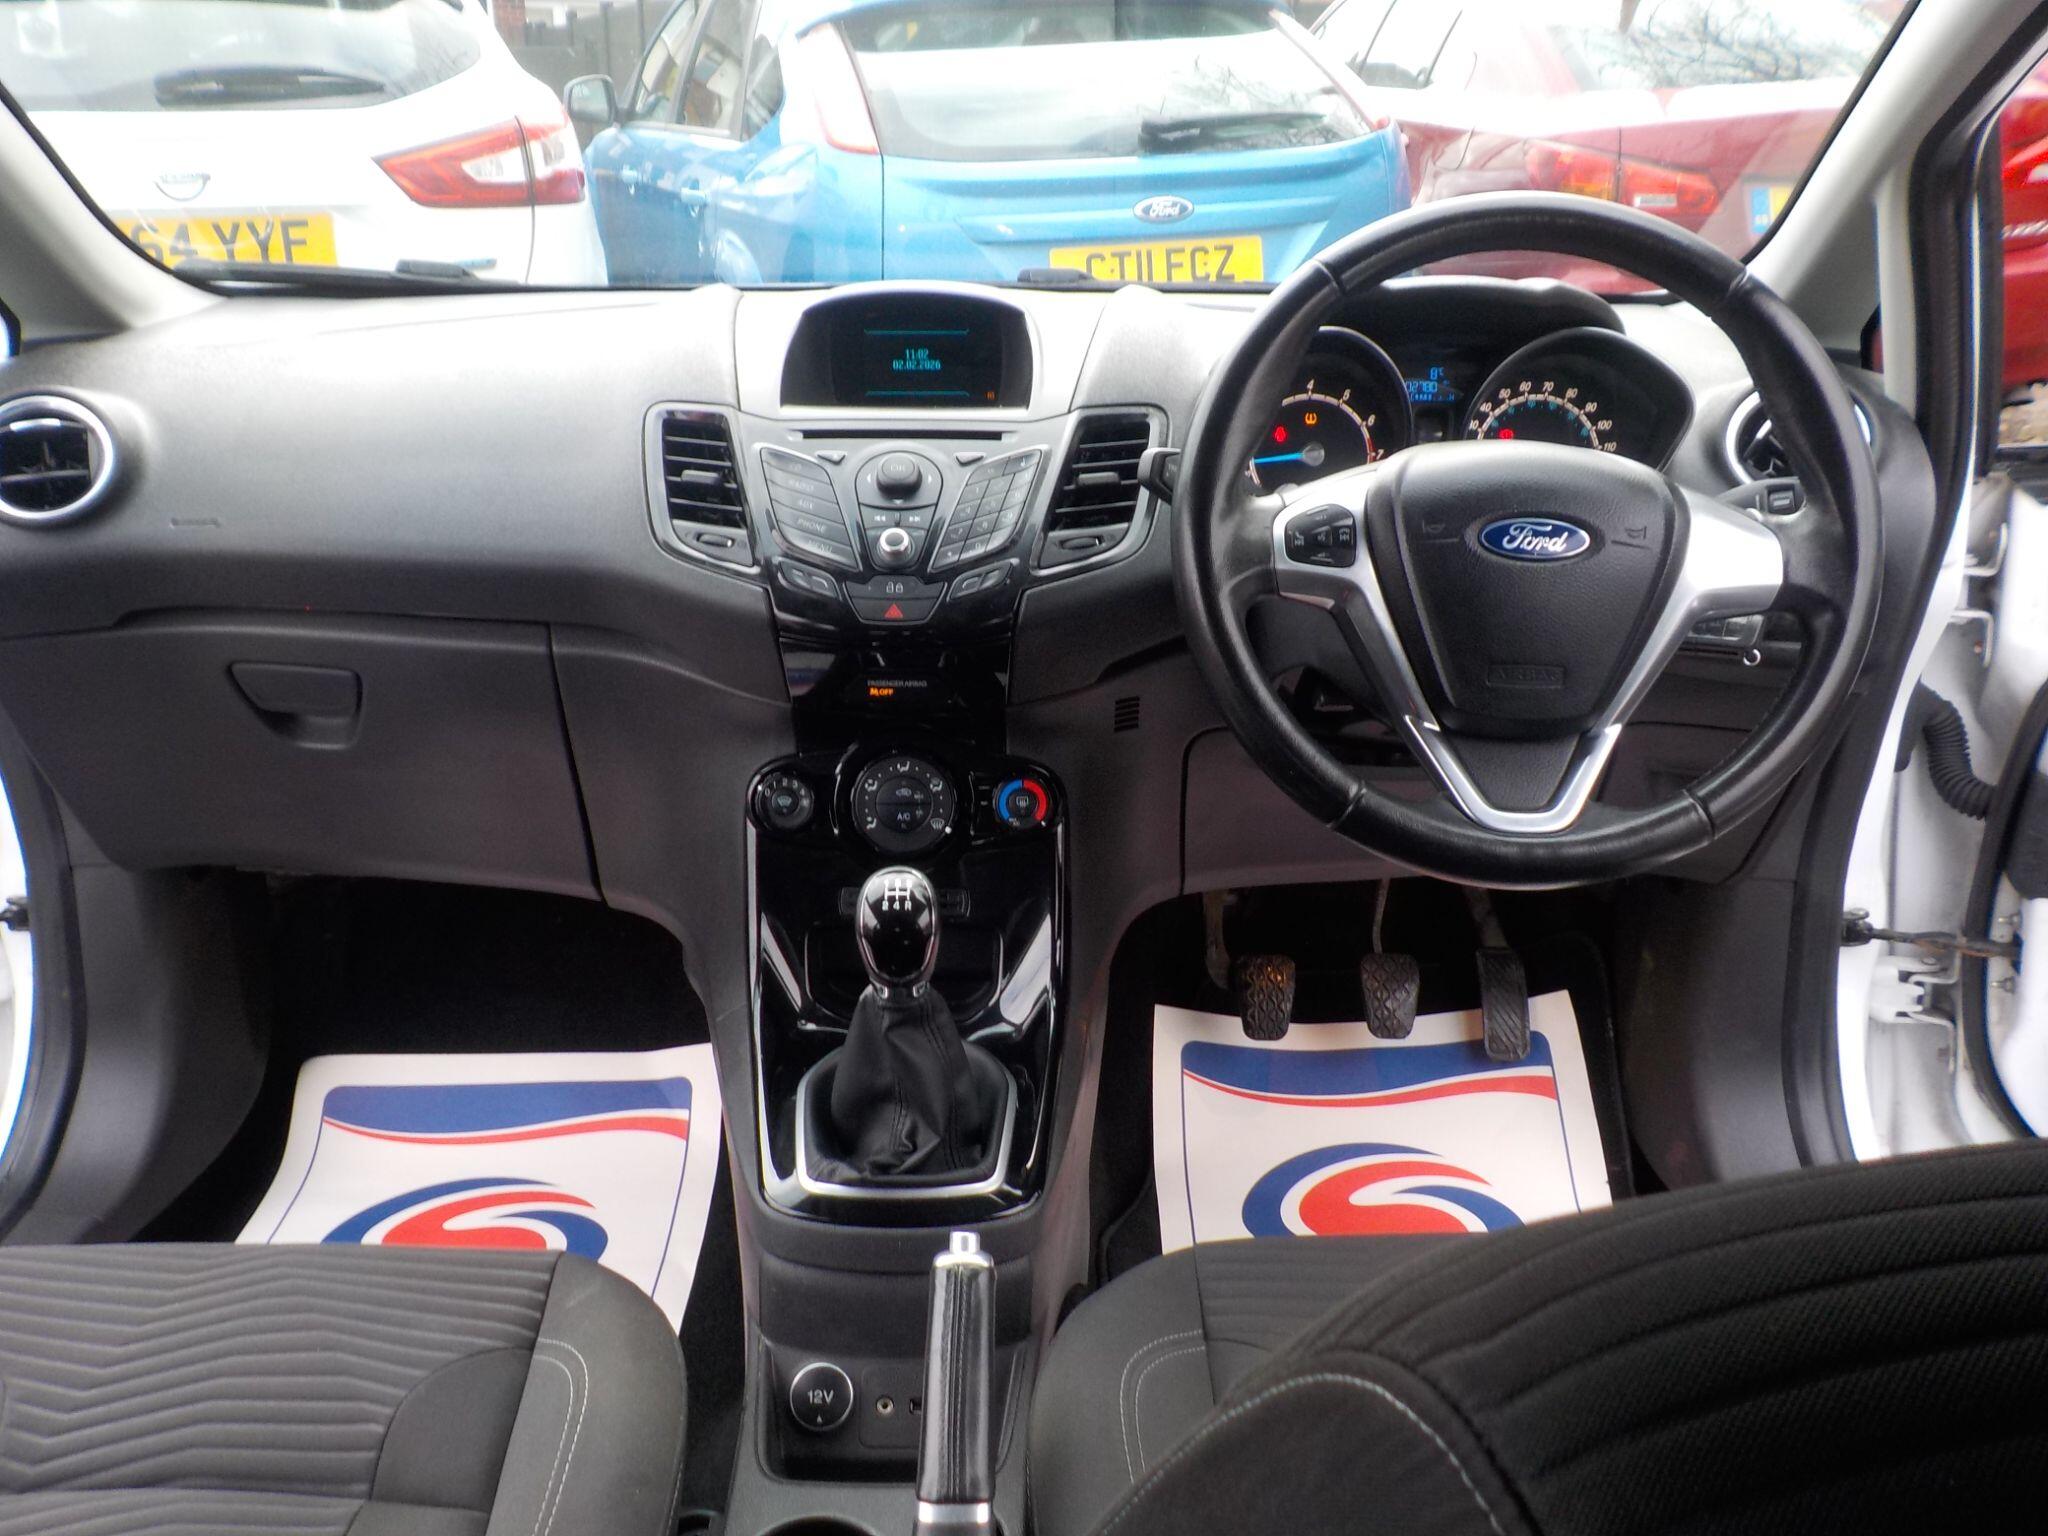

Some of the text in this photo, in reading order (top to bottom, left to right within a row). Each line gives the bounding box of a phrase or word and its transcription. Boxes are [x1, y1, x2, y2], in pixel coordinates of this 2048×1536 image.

[1165, 244, 1235, 281] FCZ
[1306, 379, 1315, 390] 4
[1519, 381, 1532, 392] 60
[1543, 381, 1555, 392] 70
[1342, 388, 1351, 400] 5
[1499, 388, 1511, 399] 50
[1566, 388, 1578, 399] 80
[1479, 402, 1492, 412] 40
[1585, 402, 1597, 412] 90
[1367, 414, 1376, 426] 6
[1597, 420, 1613, 430] 100
[1603, 441, 1617, 452] 110
[1376, 448, 1385, 460] 7
[1502, 523, 1569, 552] Ford
[879, 688, 894, 697] OFF
[897, 811, 911, 821] A/C
[893, 900, 900, 911] 4
[807, 1389, 834, 1405] 12V
